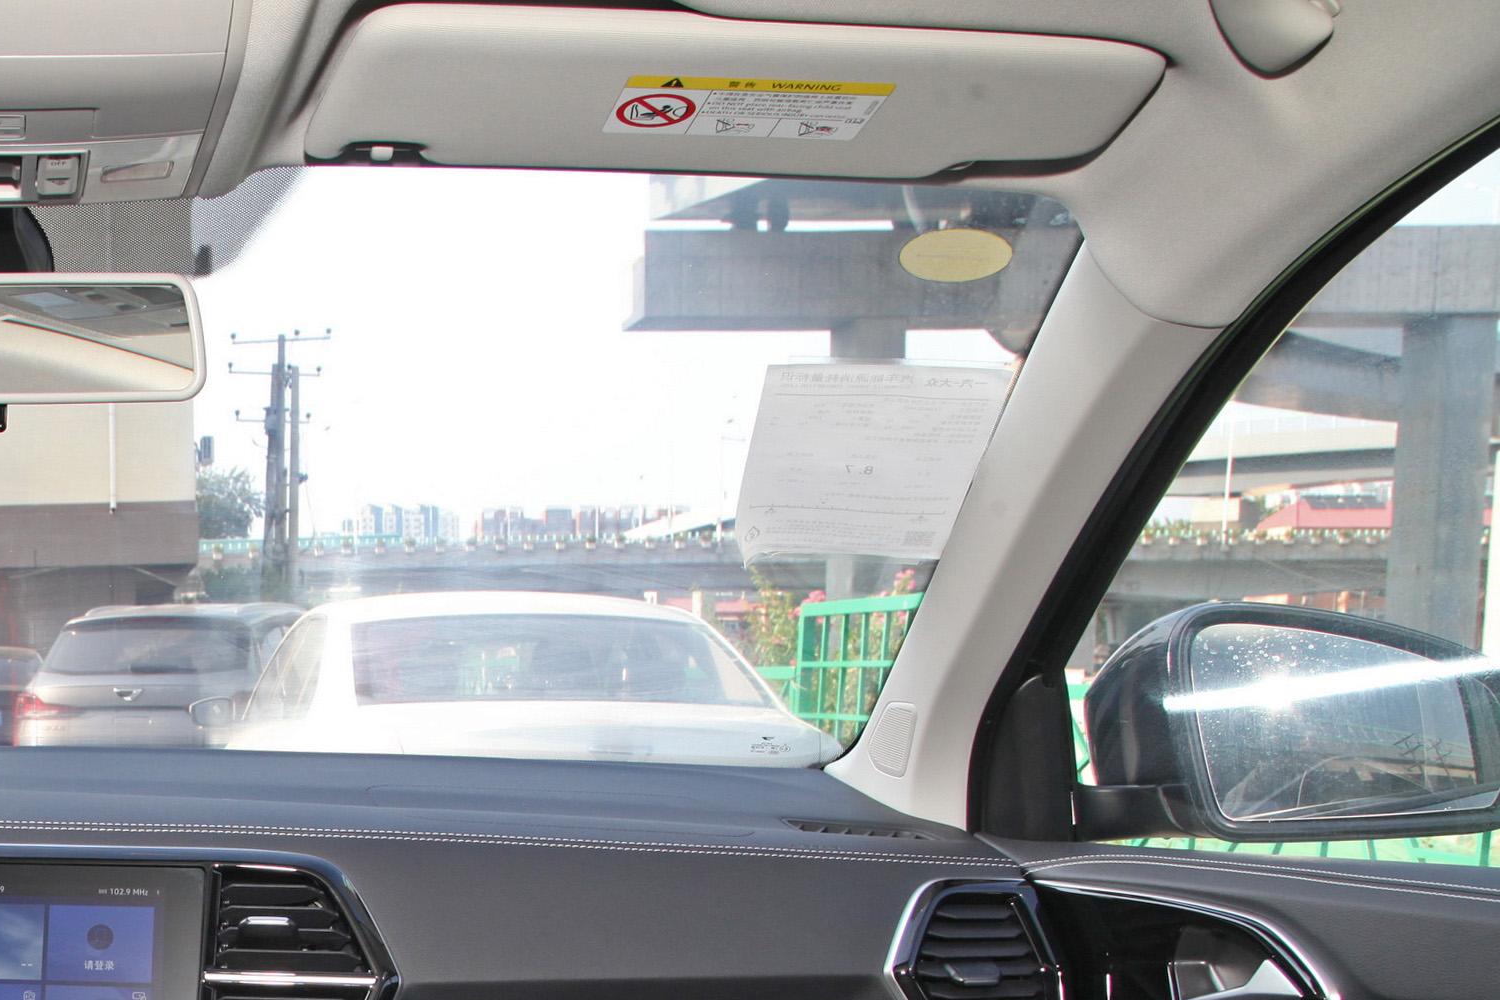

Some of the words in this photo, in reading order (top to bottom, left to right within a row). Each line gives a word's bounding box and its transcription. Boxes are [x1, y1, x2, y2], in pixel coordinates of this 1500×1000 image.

[771, 82, 842, 91] WARNING
[109, 888, 131, 896] 102.9
[132, 888, 149, 896] MHz
[84, 960, 115, 971] 请登录
